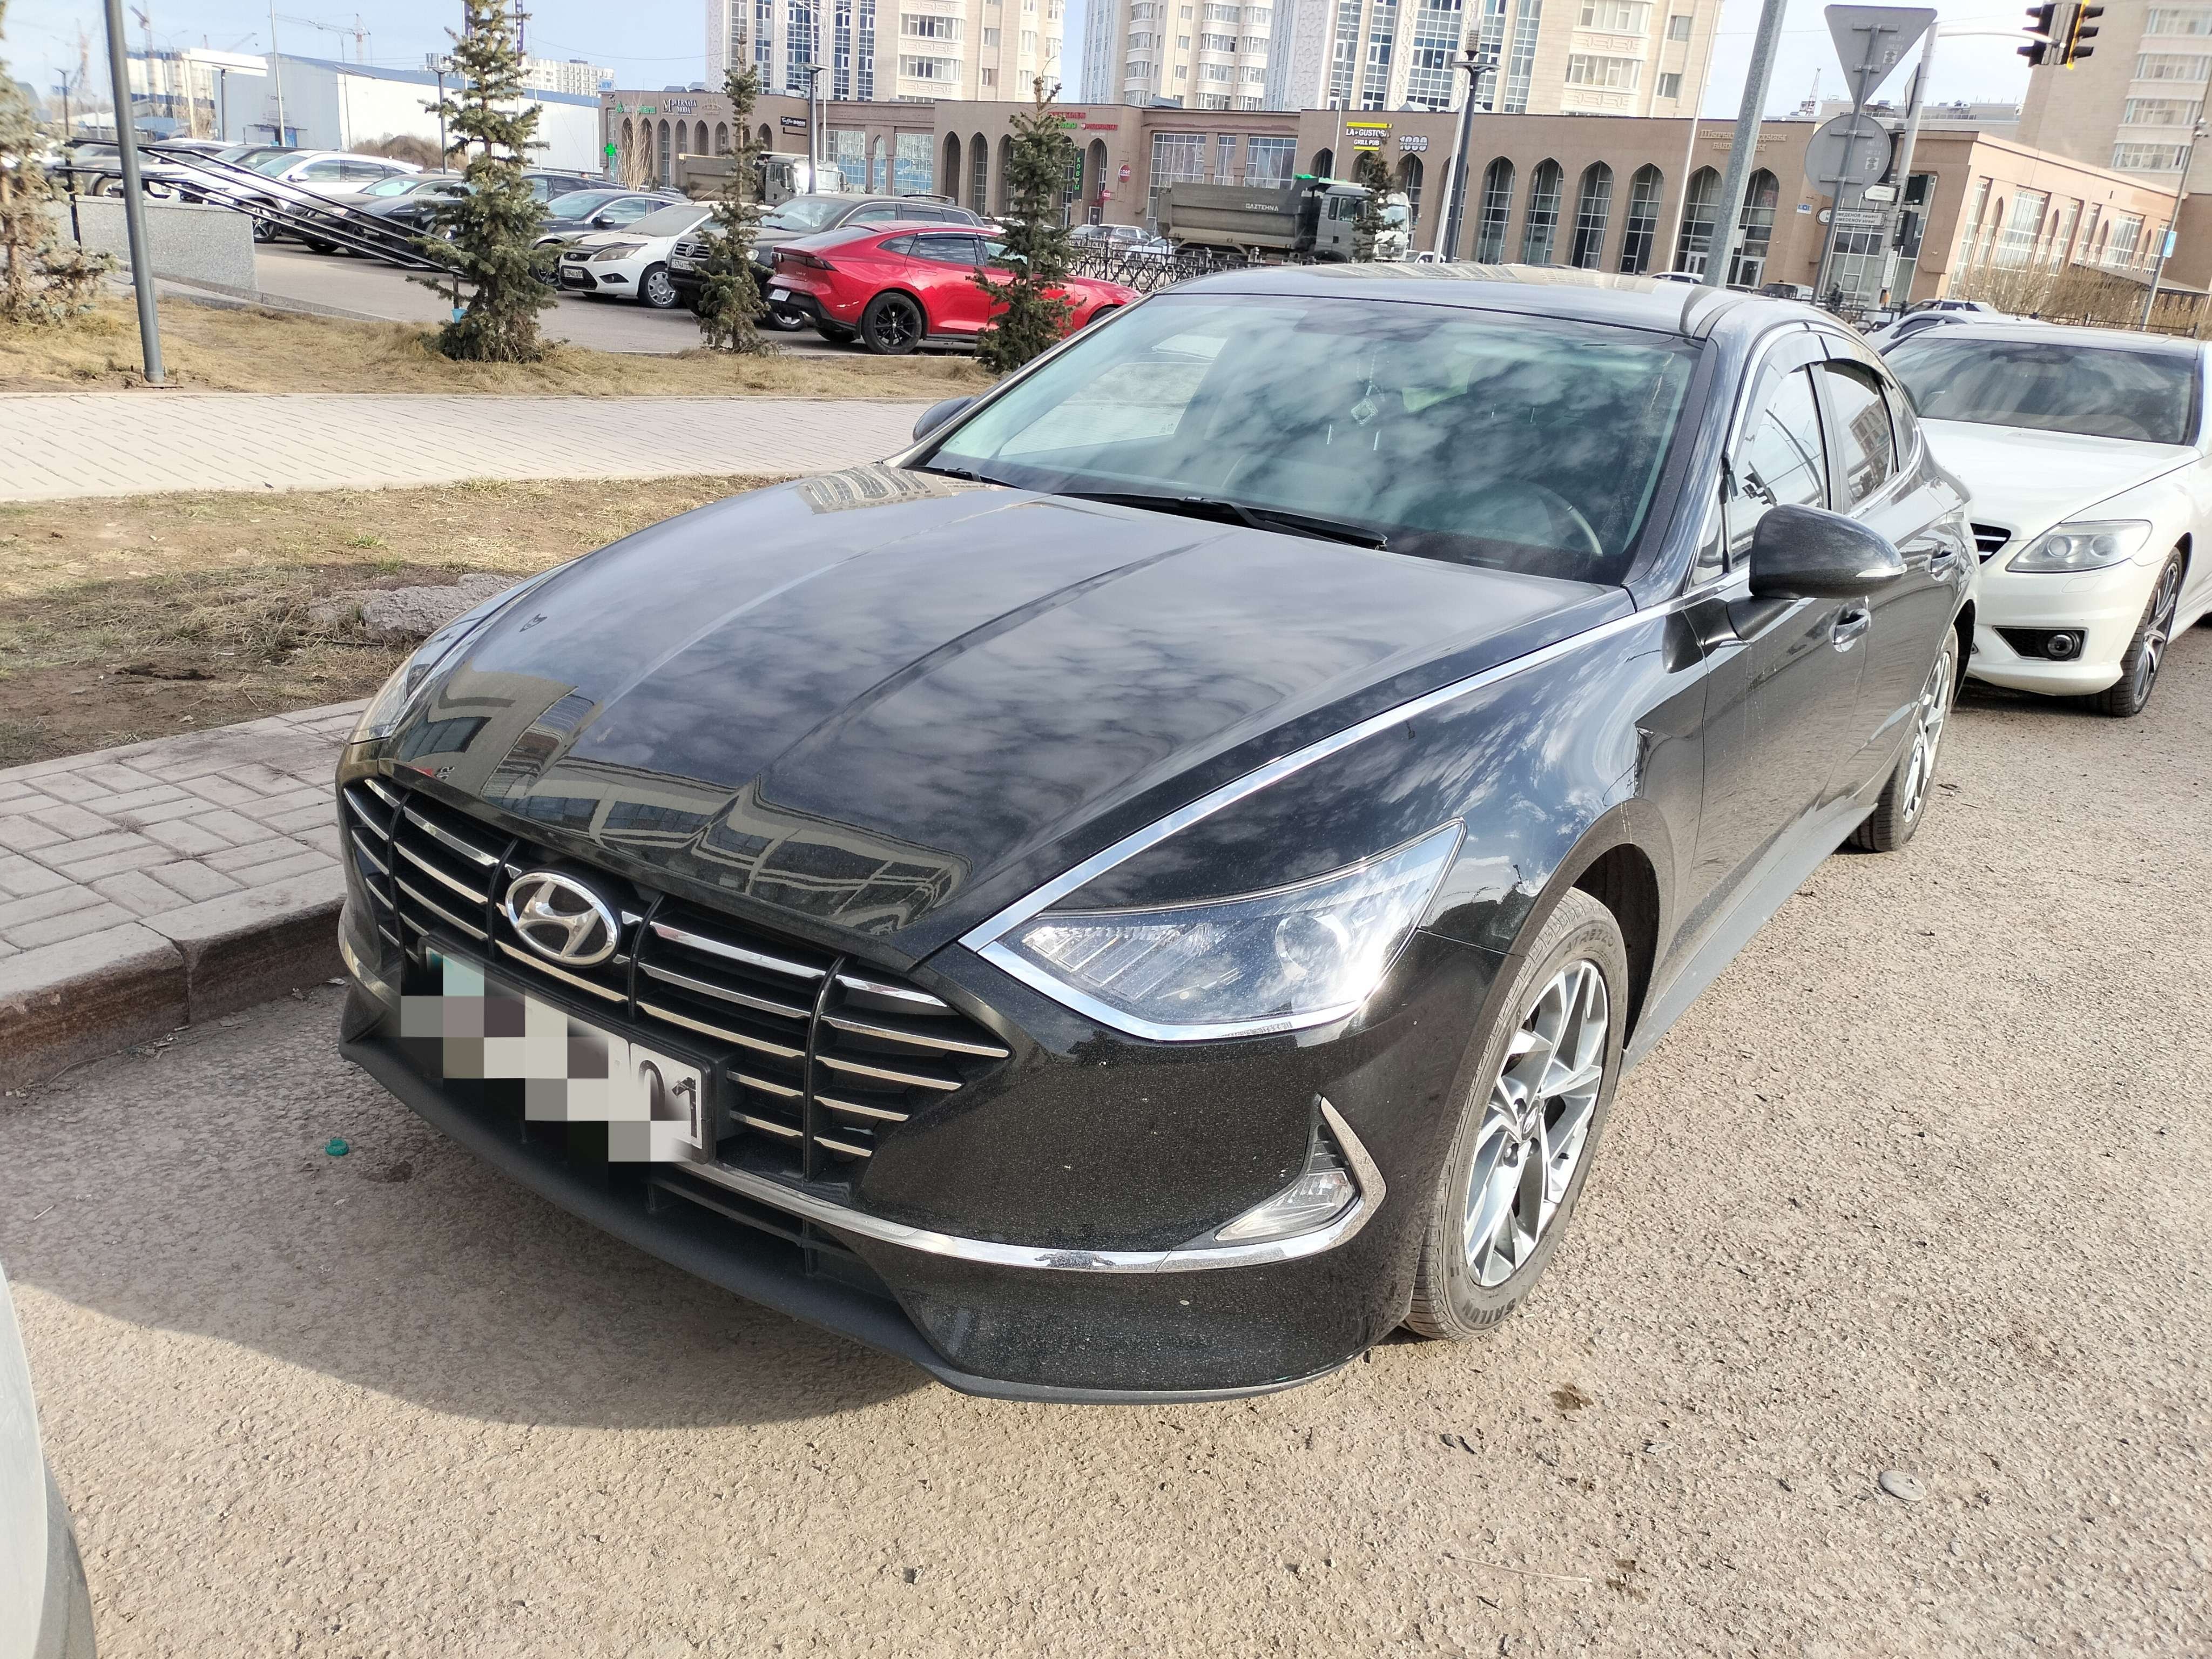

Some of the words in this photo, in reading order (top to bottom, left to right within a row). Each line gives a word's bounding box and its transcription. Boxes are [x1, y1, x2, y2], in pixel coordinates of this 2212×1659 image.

[672, 99, 697, 107] DVERNAYA
[1562, 928, 1615, 958] ATREZZO
[1462, 1298, 1516, 1324] SAILUN
